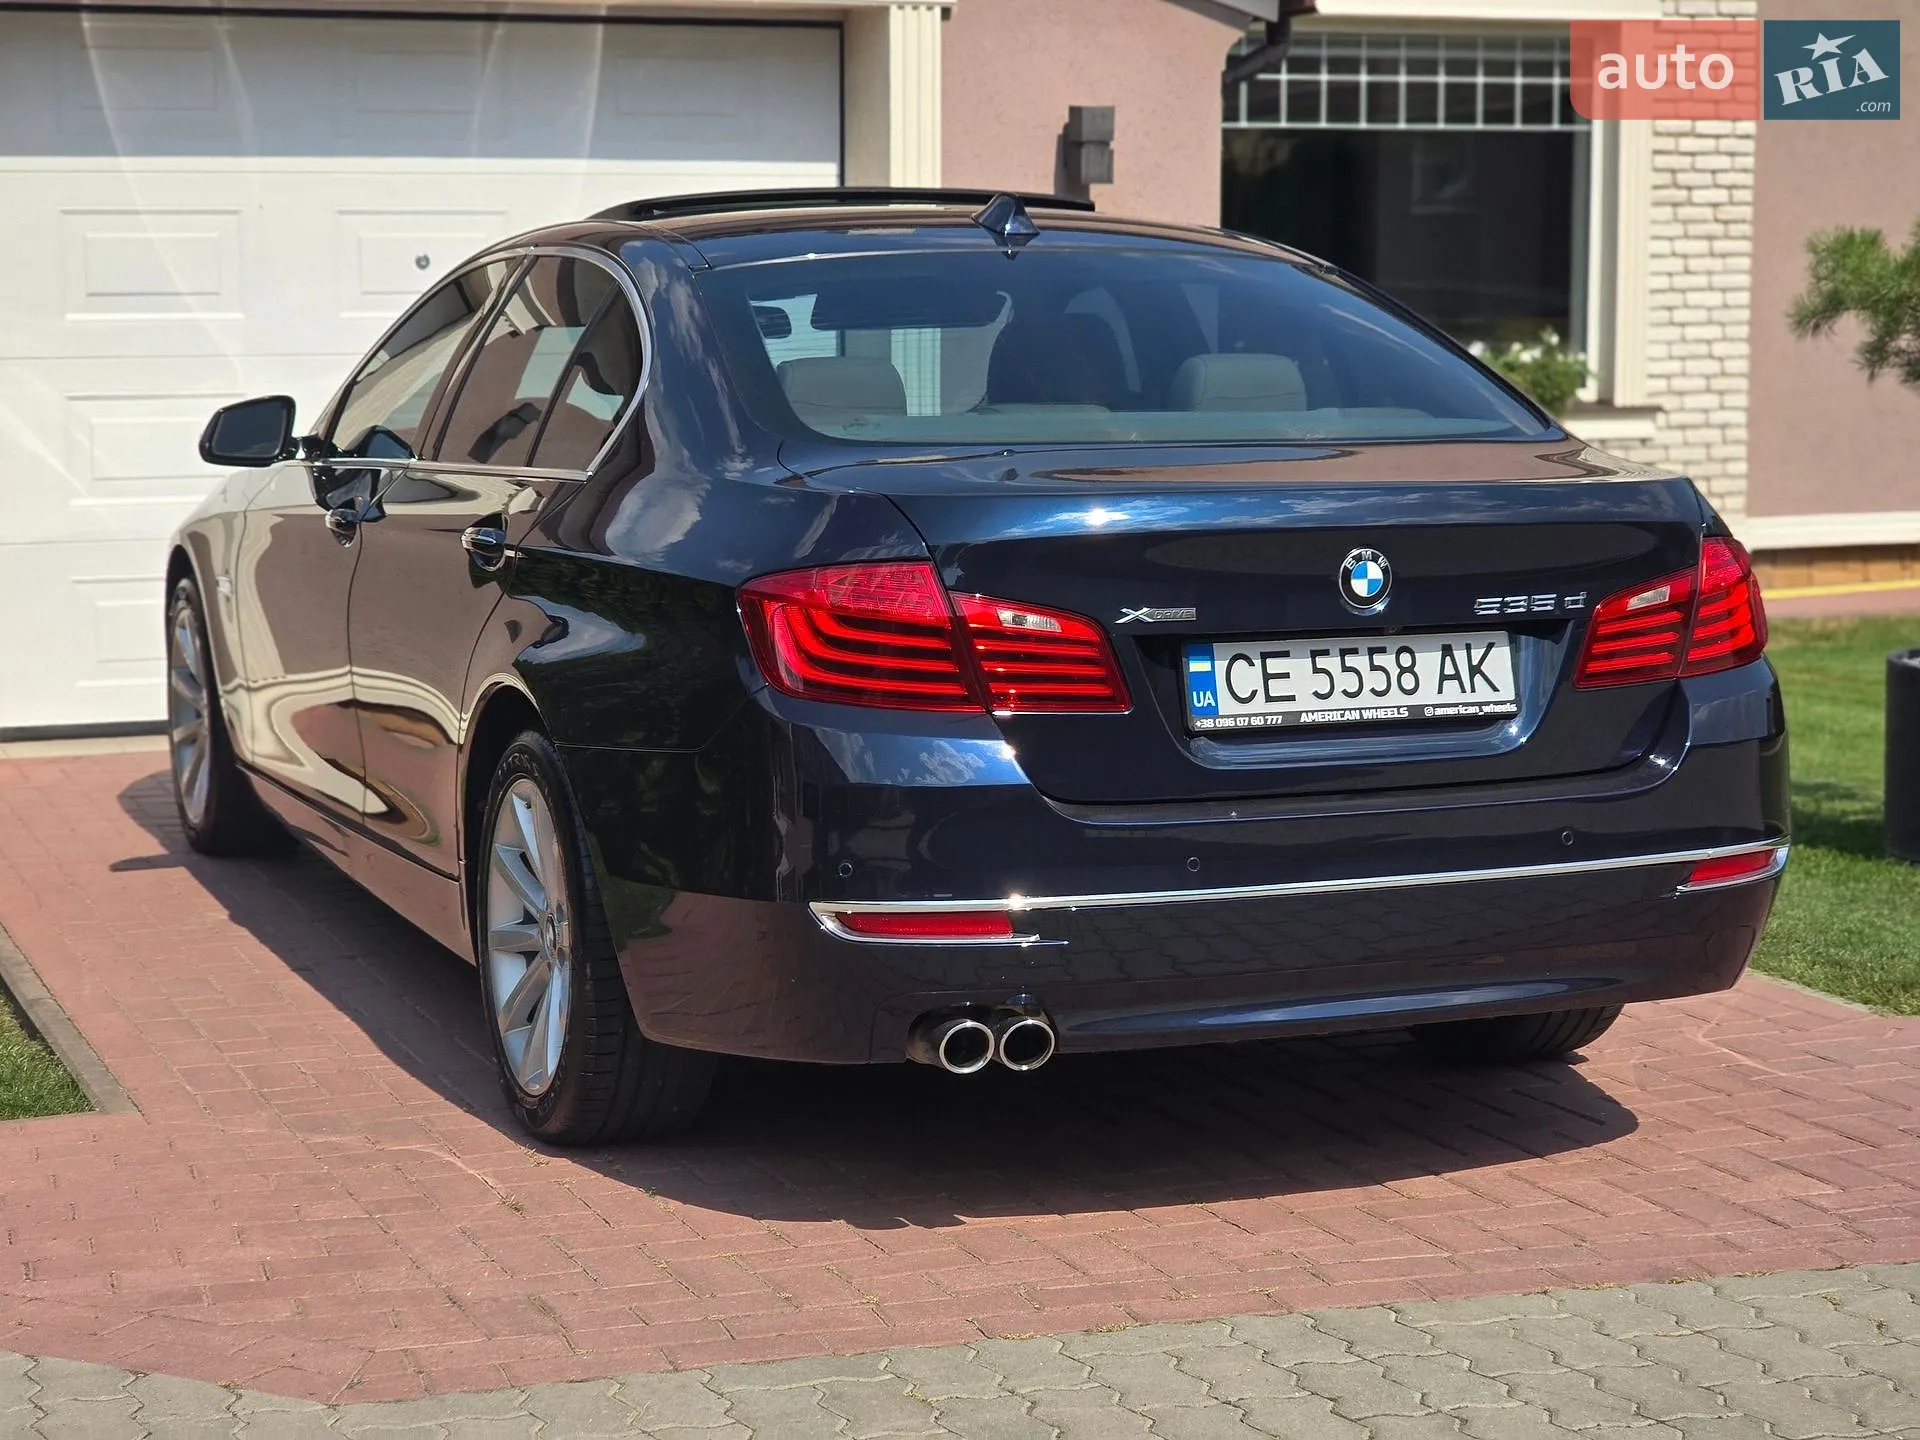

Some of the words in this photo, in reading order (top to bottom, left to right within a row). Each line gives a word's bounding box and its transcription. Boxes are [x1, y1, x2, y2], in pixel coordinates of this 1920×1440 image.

[1225, 650, 1296, 704] CE
[1310, 645, 1420, 700] 5558
[1437, 642, 1500, 695] AK
[1193, 690, 1216, 708] UA
[1216, 716, 1235, 727] 096
[1237, 716, 1249, 726] 07
[1250, 715, 1265, 726] 60
[1266, 715, 1283, 725] 777
[1300, 709, 1360, 723] AMERICAN
[1361, 707, 1408, 720] WHEELS
